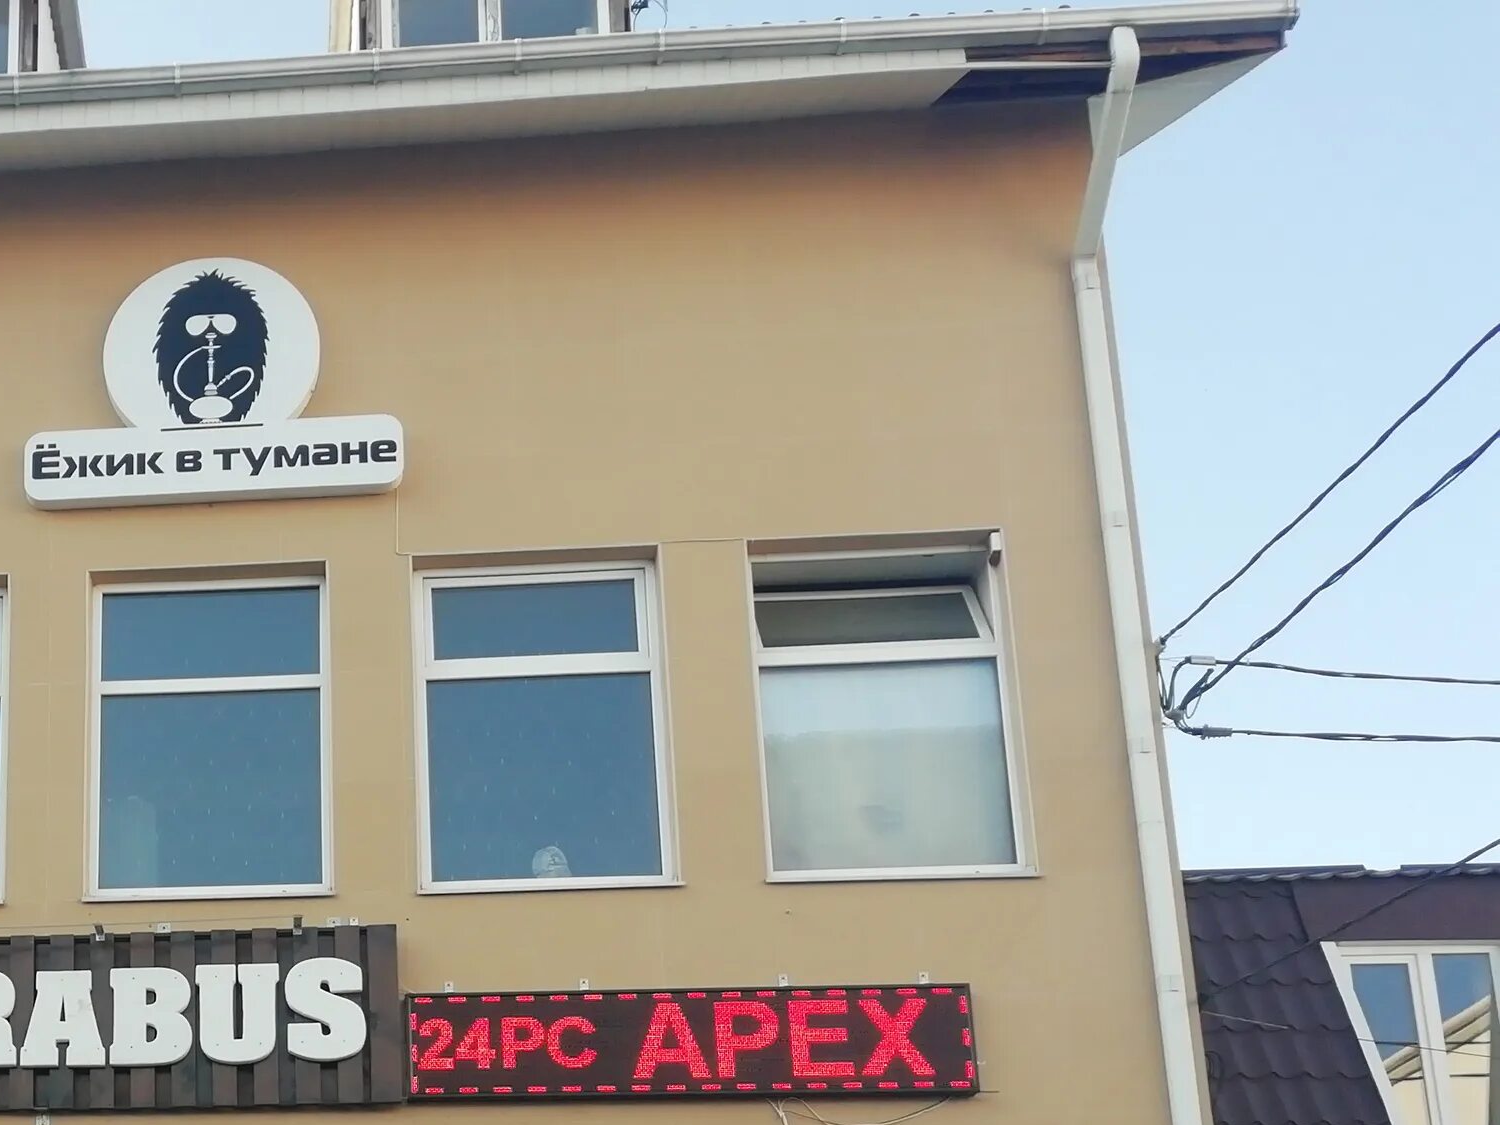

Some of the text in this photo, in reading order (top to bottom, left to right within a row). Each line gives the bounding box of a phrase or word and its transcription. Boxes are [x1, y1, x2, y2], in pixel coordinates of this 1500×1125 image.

[31, 439, 398, 480] Ёжик в тумане
[417, 997, 937, 1080] 24PC APEX
